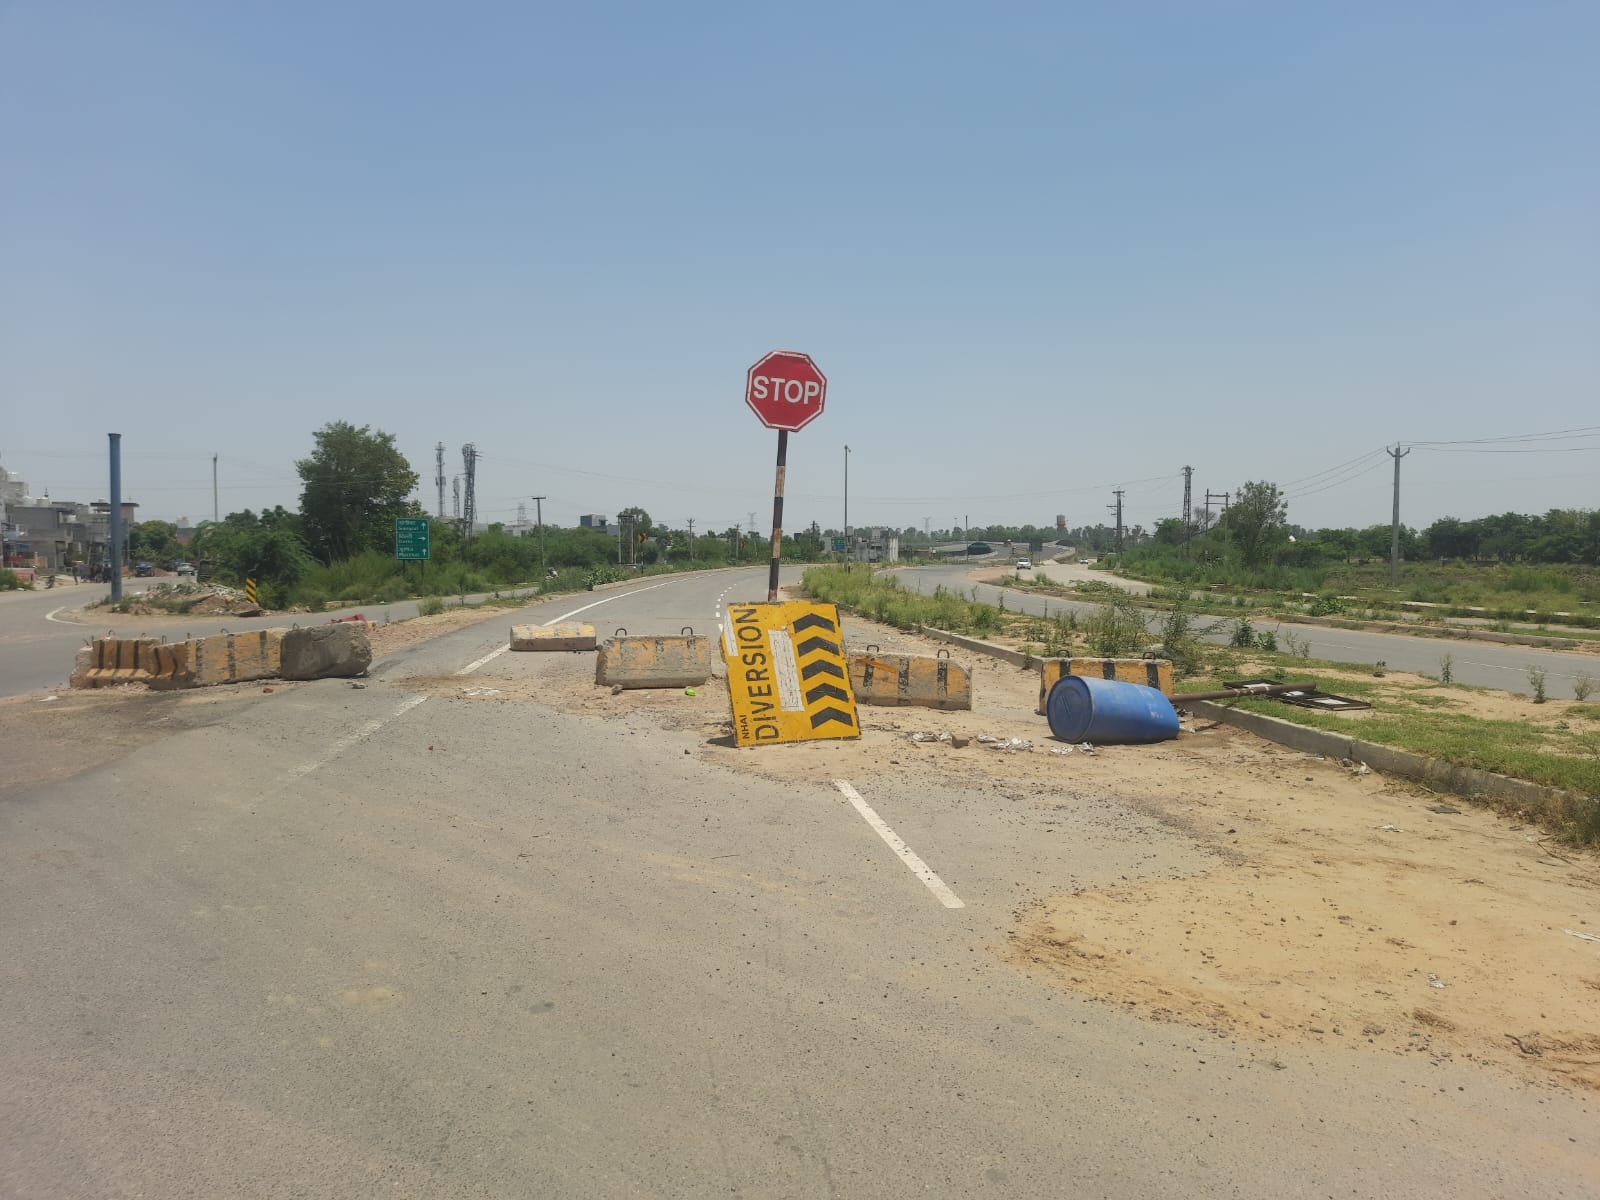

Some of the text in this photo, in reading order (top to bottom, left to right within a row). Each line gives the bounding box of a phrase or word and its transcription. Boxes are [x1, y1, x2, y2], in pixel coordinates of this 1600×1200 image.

[752, 375, 820, 405] STOP
[734, 608, 779, 741] DIVERSION
[739, 714, 750, 739] NHAI
